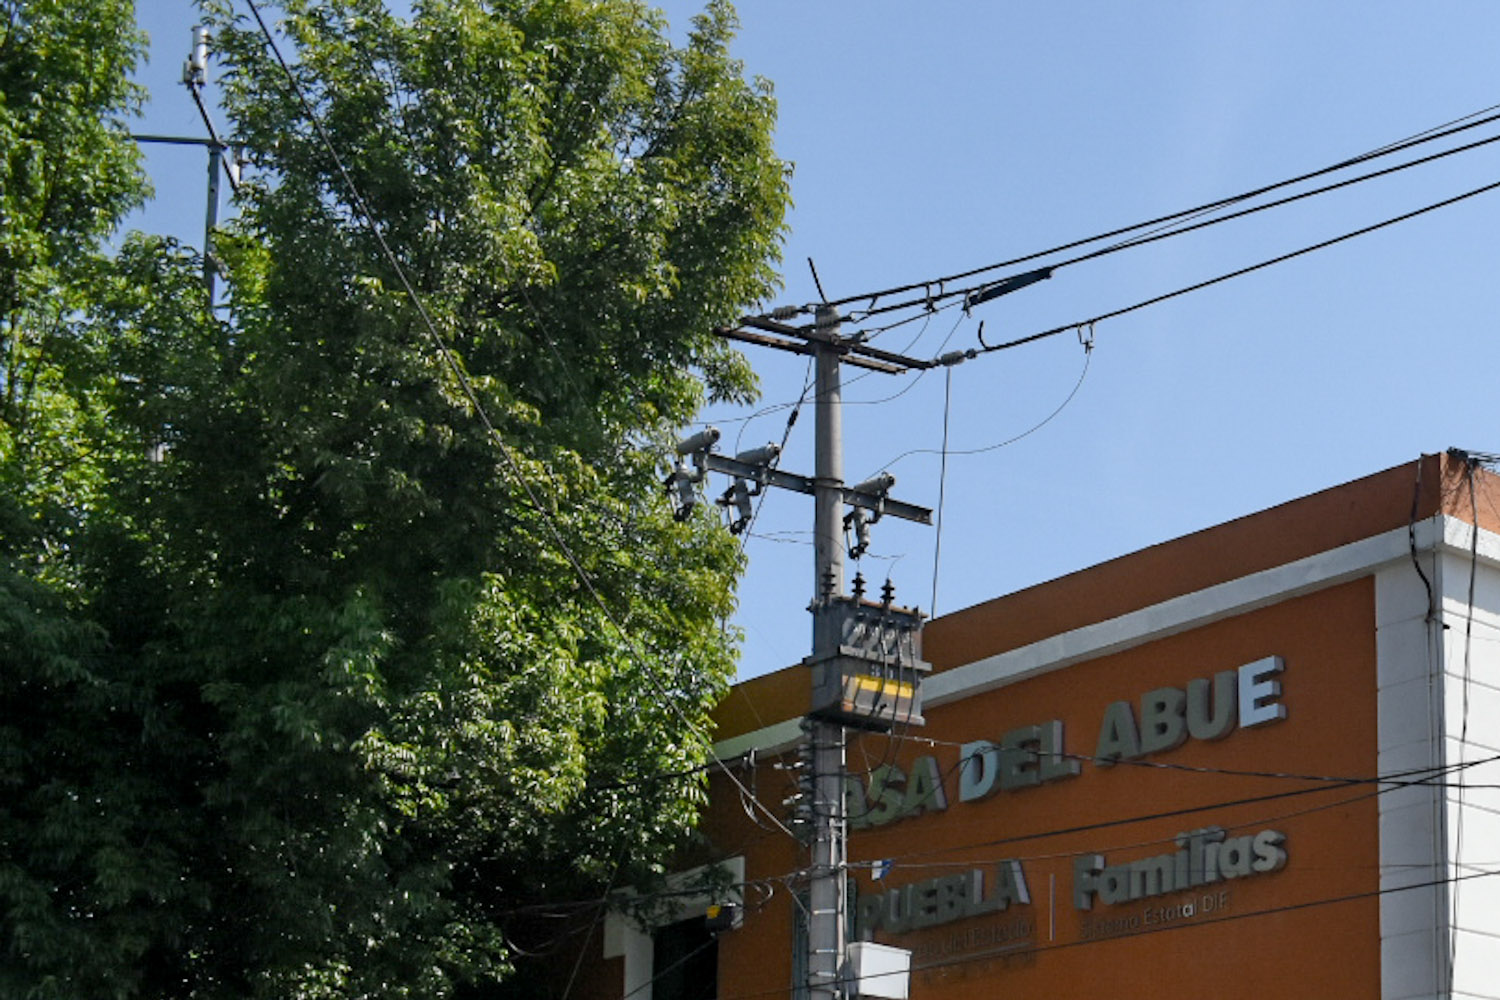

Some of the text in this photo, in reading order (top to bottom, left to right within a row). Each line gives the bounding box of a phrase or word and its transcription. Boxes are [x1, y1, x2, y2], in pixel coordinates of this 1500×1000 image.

[959, 720, 1081, 801] DEL
[1094, 655, 1287, 766] ABUE
[857, 858, 1031, 942] PUEBLA
[1073, 825, 1287, 910] Familias
[1143, 901, 1199, 925] Estatal
[1201, 893, 1229, 913] DIF
